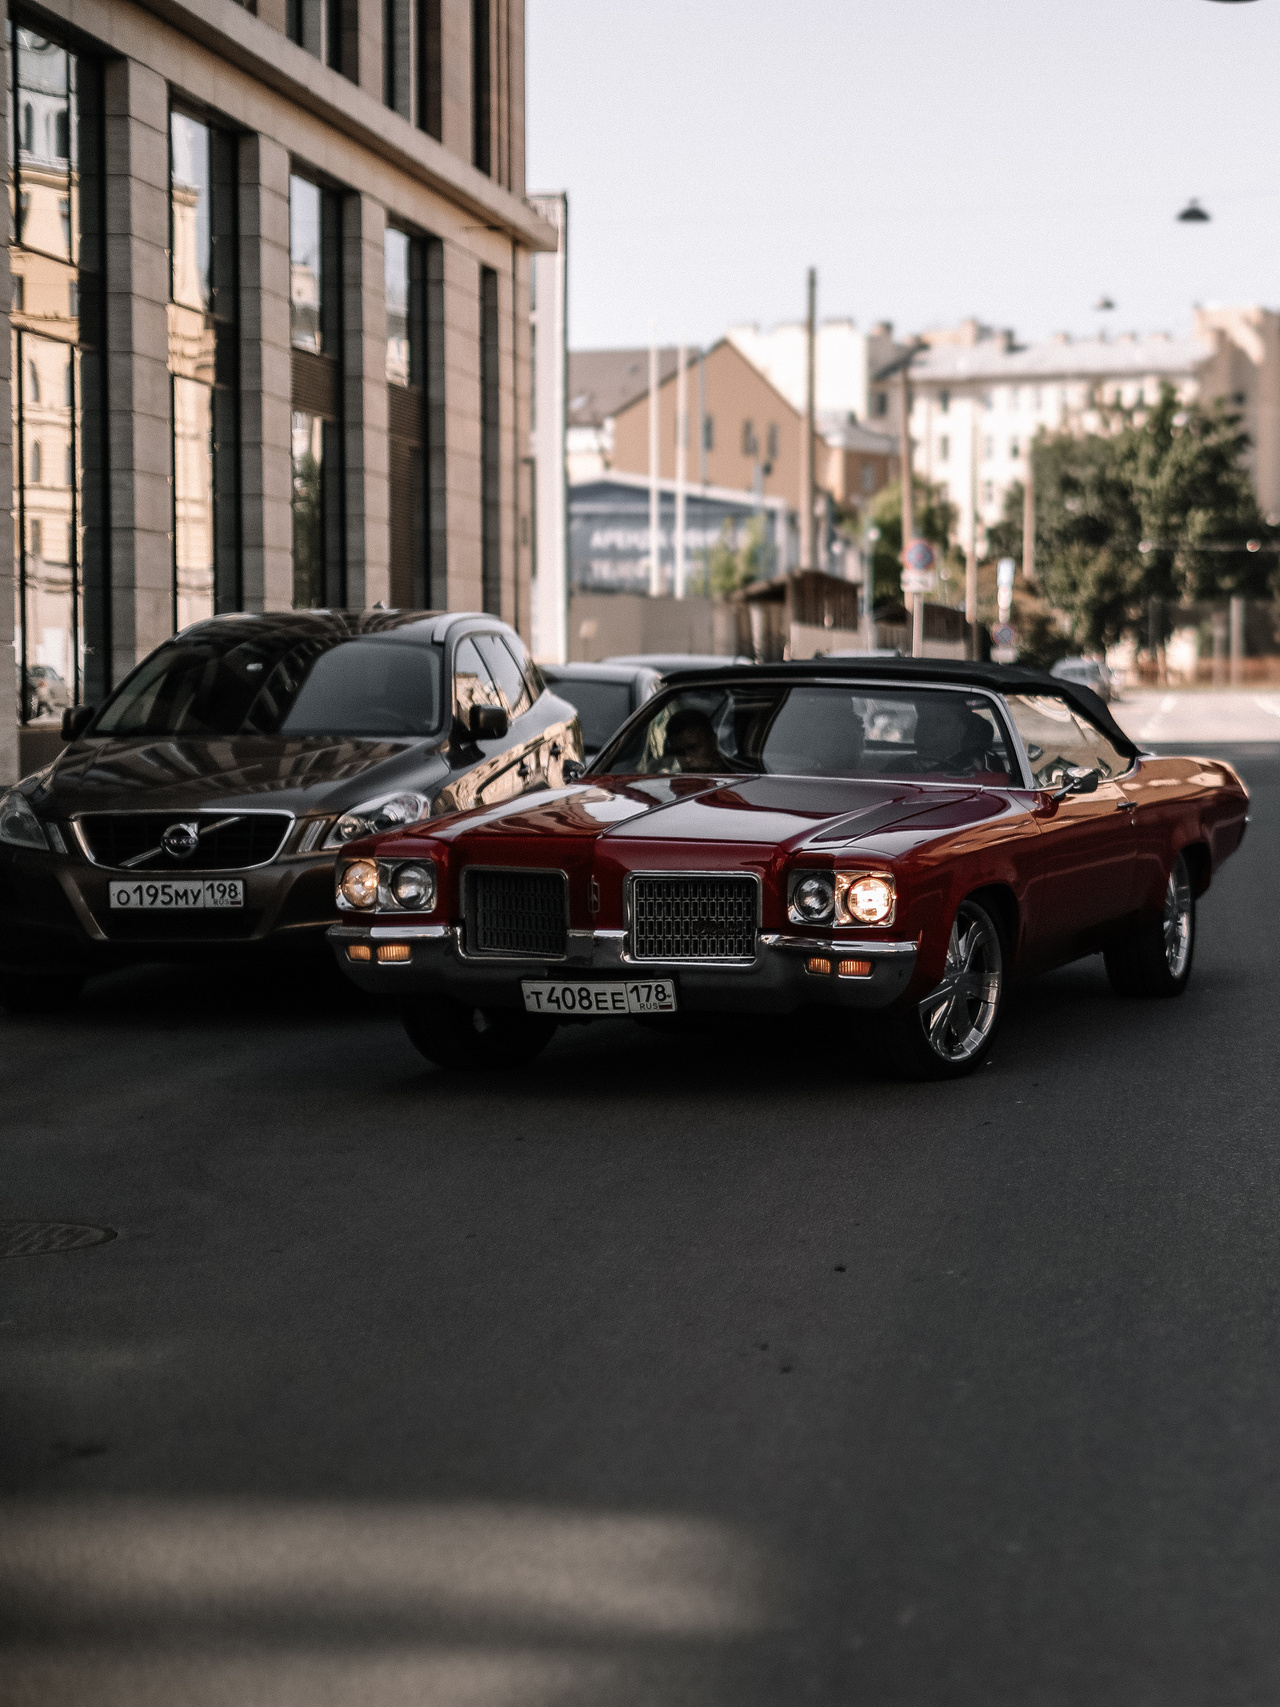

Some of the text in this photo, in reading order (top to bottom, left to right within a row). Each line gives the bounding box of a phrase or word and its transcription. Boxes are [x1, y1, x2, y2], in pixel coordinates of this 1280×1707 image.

[116, 882, 239, 906] О195МУ 198
[531, 984, 667, 1011] Т408ЕЕ 178
